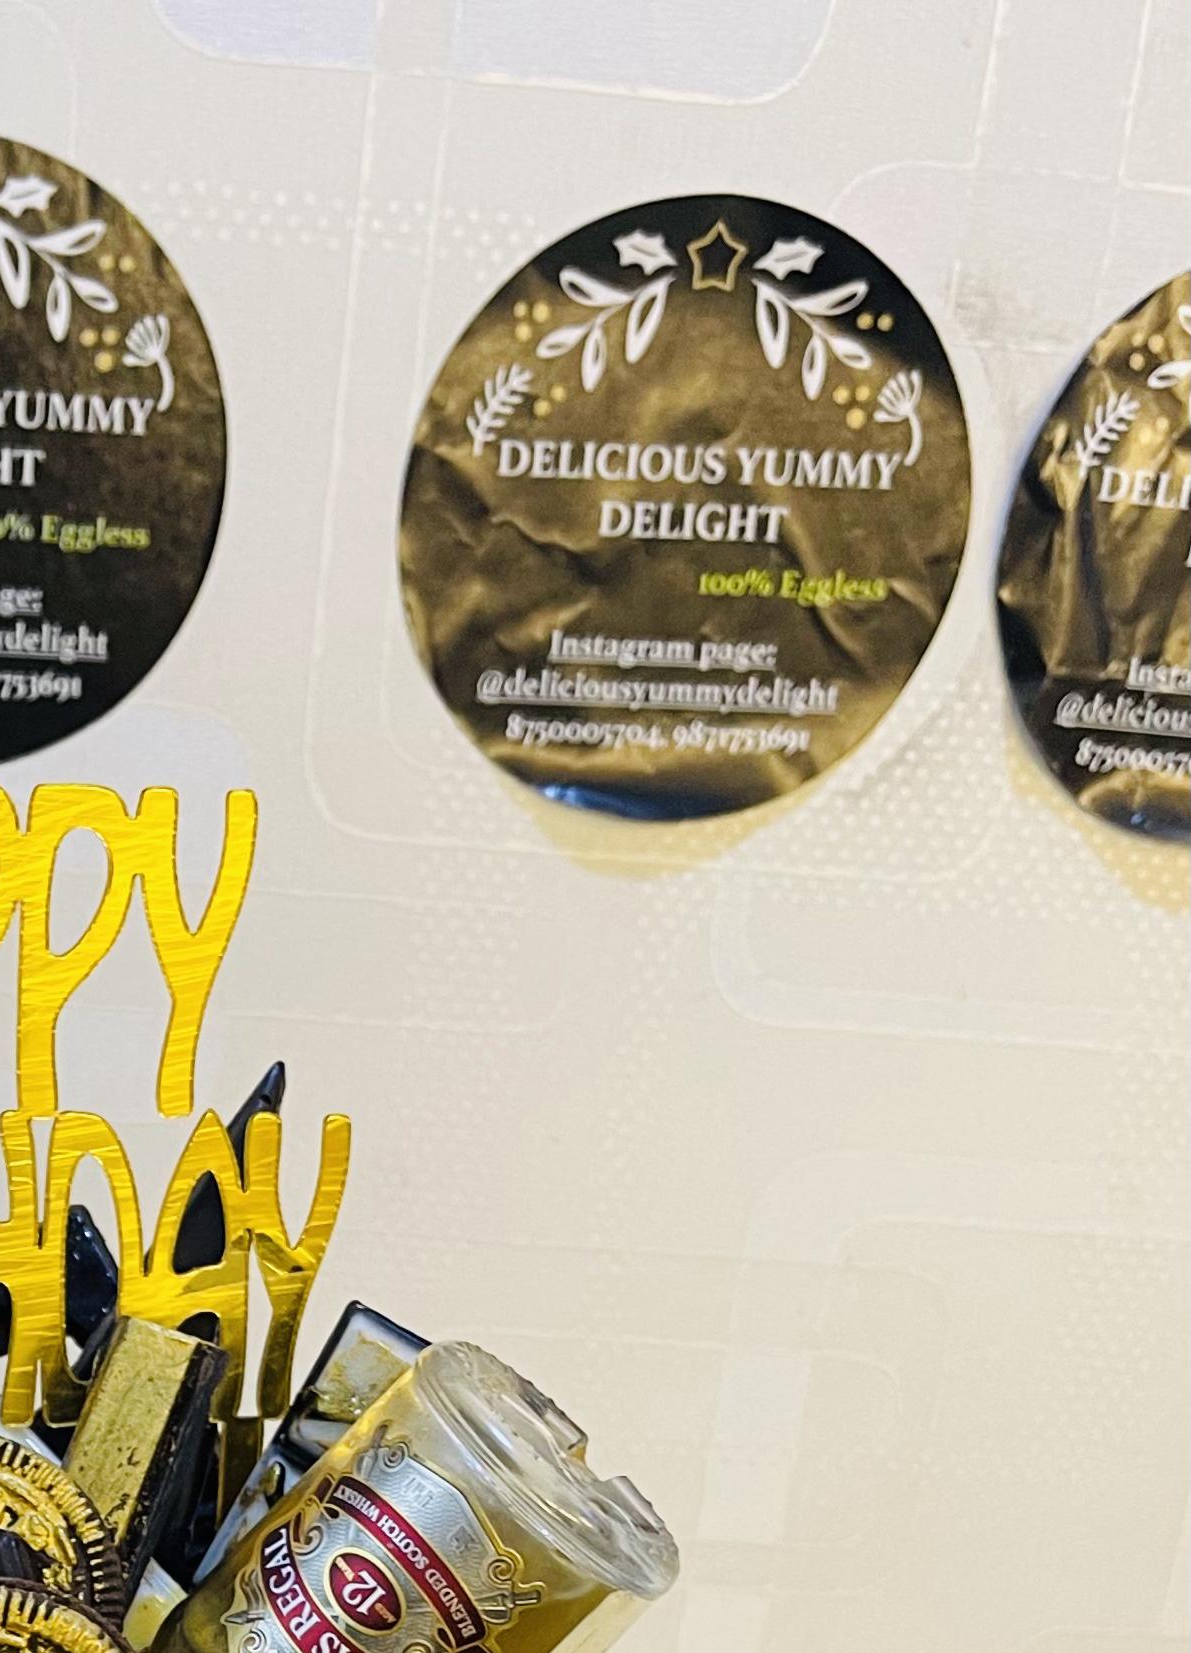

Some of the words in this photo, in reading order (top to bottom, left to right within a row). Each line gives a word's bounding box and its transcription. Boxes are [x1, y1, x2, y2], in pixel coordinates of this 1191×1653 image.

[496, 437, 726, 484] DELICIOUS
[738, 445, 904, 492] YUMMY
[41, 514, 150, 553] Eggless
[599, 500, 790, 545] DELIGHT
[699, 569, 775, 598] 100%
[780, 570, 888, 607] Eggless
[549, 628, 695, 668] Instagram
[699, 641, 778, 672] page:
[476, 666, 839, 716] @deliciousyummydelight
[1125, 656, 1191, 695] Insta
[333, 1485, 380, 1522] WHISKY
[377, 1515, 430, 1570] SCOTCH
[263, 1527, 324, 1639] REGAL
[342, 1570, 387, 1616] 12
[425, 1568, 477, 1638] BLENDED
